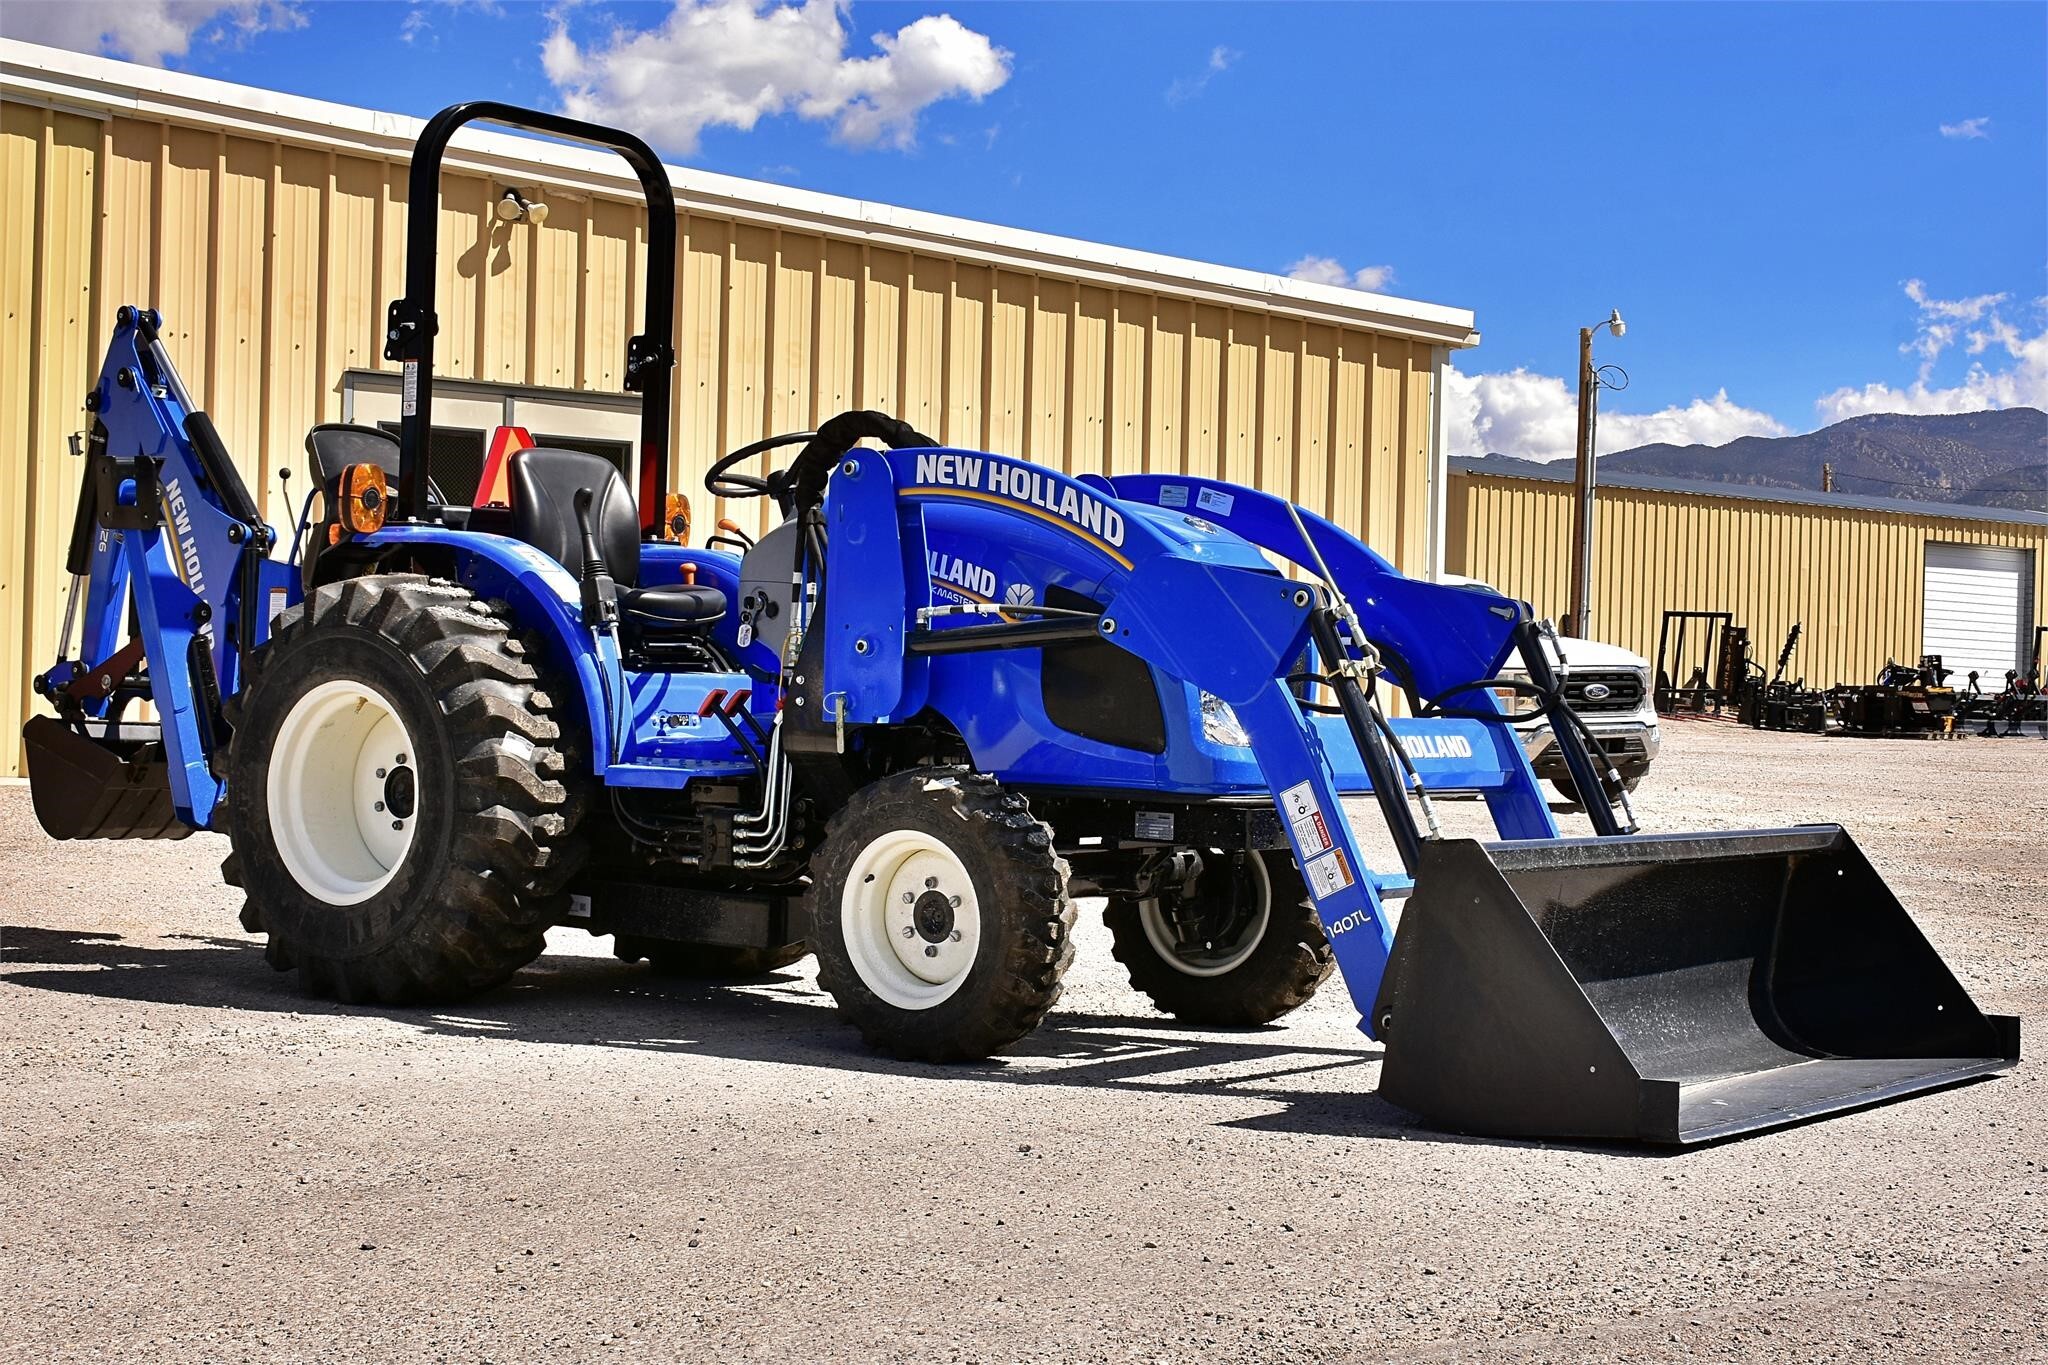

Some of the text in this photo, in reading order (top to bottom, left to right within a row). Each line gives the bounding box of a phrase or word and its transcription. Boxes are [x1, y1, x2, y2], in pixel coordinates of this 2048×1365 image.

[916, 454, 1125, 548] NEW HOLLAND
[98, 528, 109, 552] 26
[166, 478, 215, 650] NEW HOLLND
[1397, 735, 1473, 759] HOLLAND
[1316, 821, 1330, 846] DANGER
